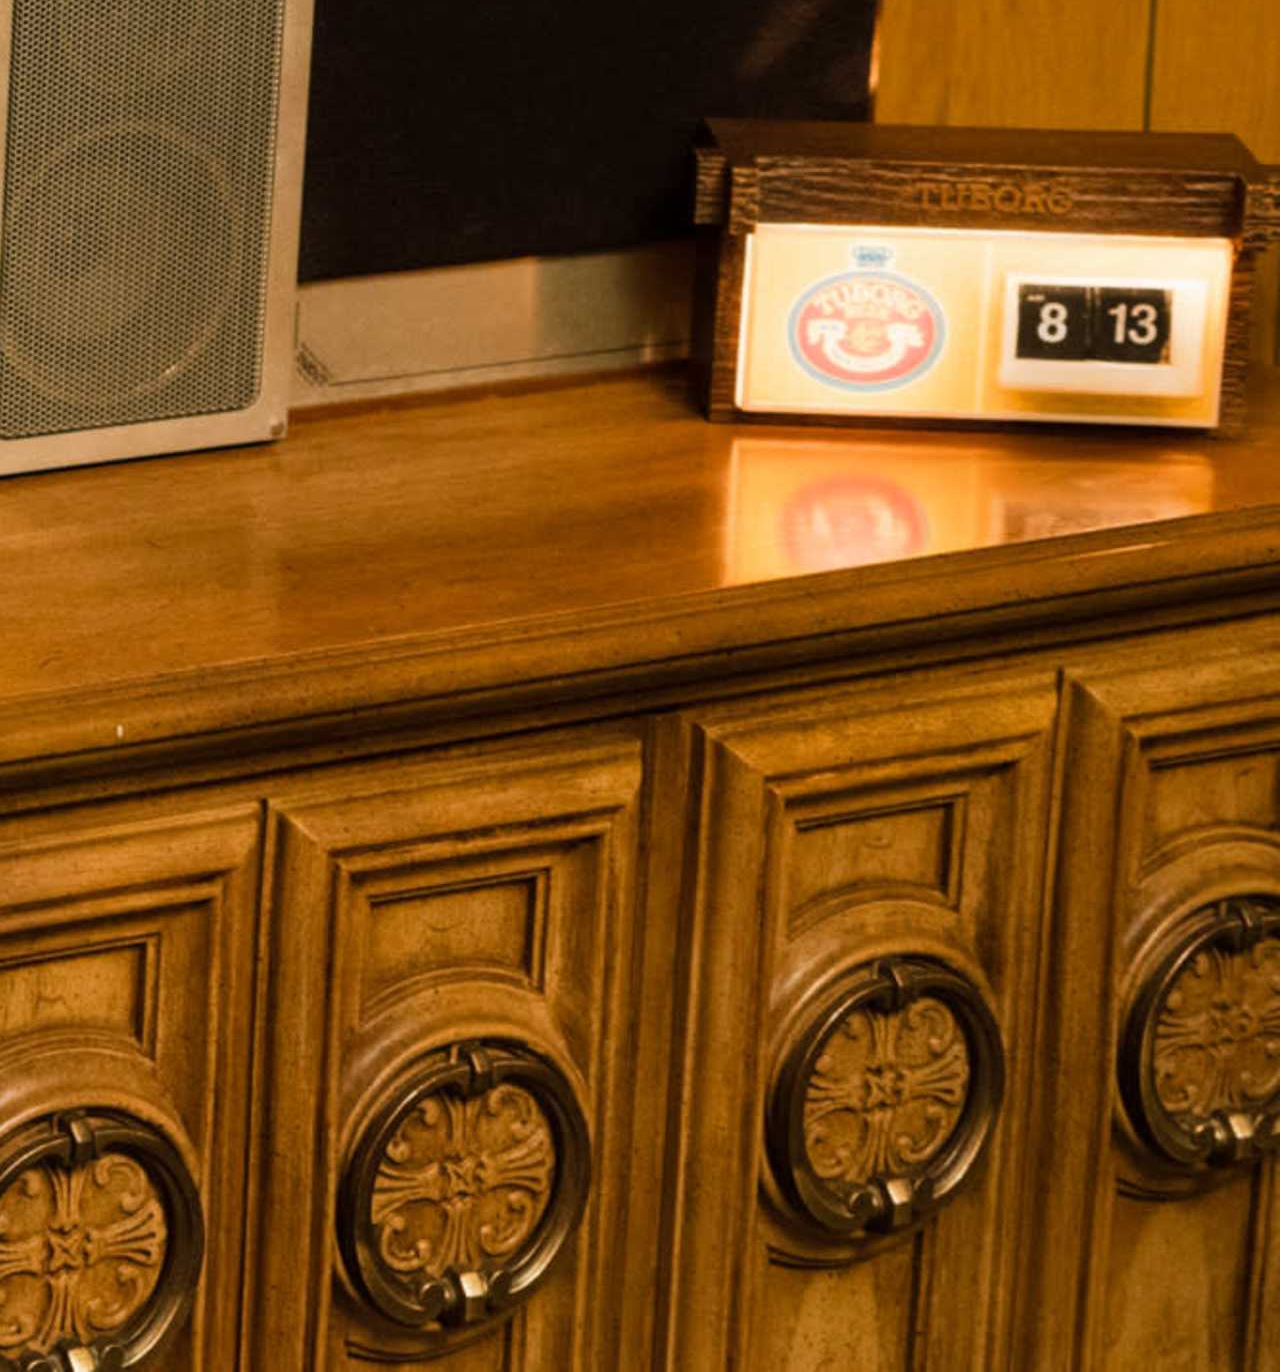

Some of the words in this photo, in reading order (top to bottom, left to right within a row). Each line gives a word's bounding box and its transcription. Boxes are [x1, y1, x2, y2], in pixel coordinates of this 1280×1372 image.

[916, 179, 1074, 215] TUBORG
[1037, 301, 1068, 344] 8
[1107, 302, 1158, 346] 13
